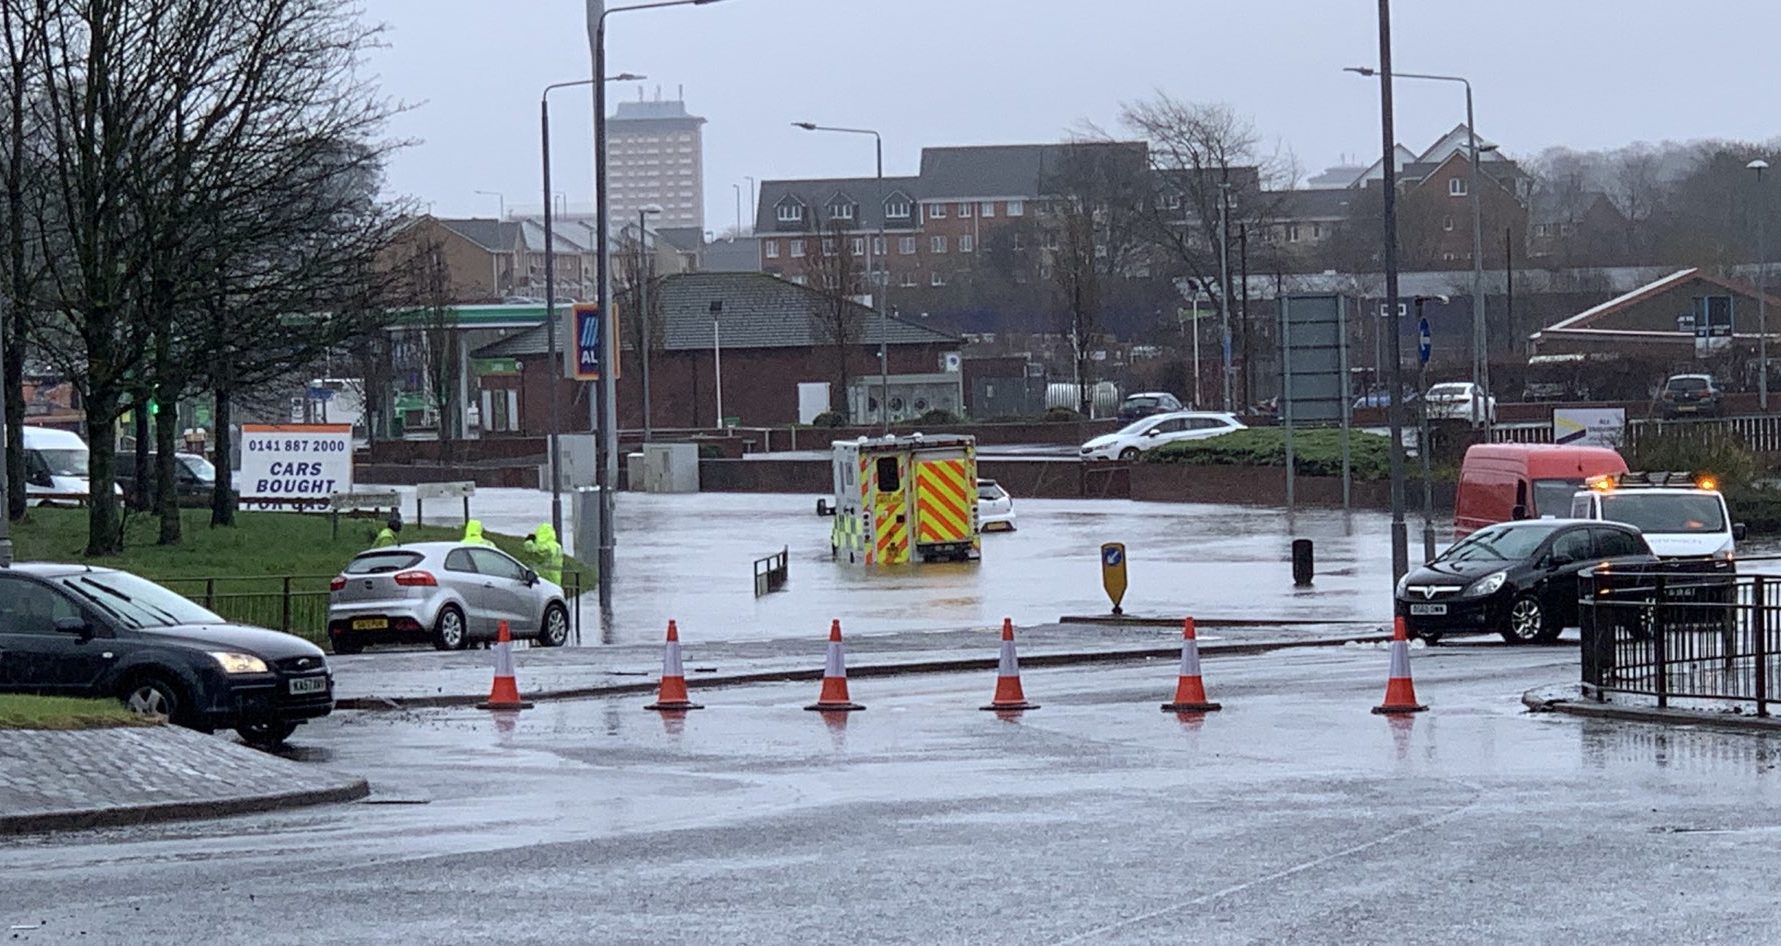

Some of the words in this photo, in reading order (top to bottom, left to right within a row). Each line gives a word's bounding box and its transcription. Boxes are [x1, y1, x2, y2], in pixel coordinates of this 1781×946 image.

[581, 350, 599, 364] AL
[249, 439, 281, 452] 0141
[284, 439, 309, 452] 887
[312, 440, 345, 452] 2000
[270, 461, 323, 476] CARS
[256, 479, 336, 494] BOUGHT
